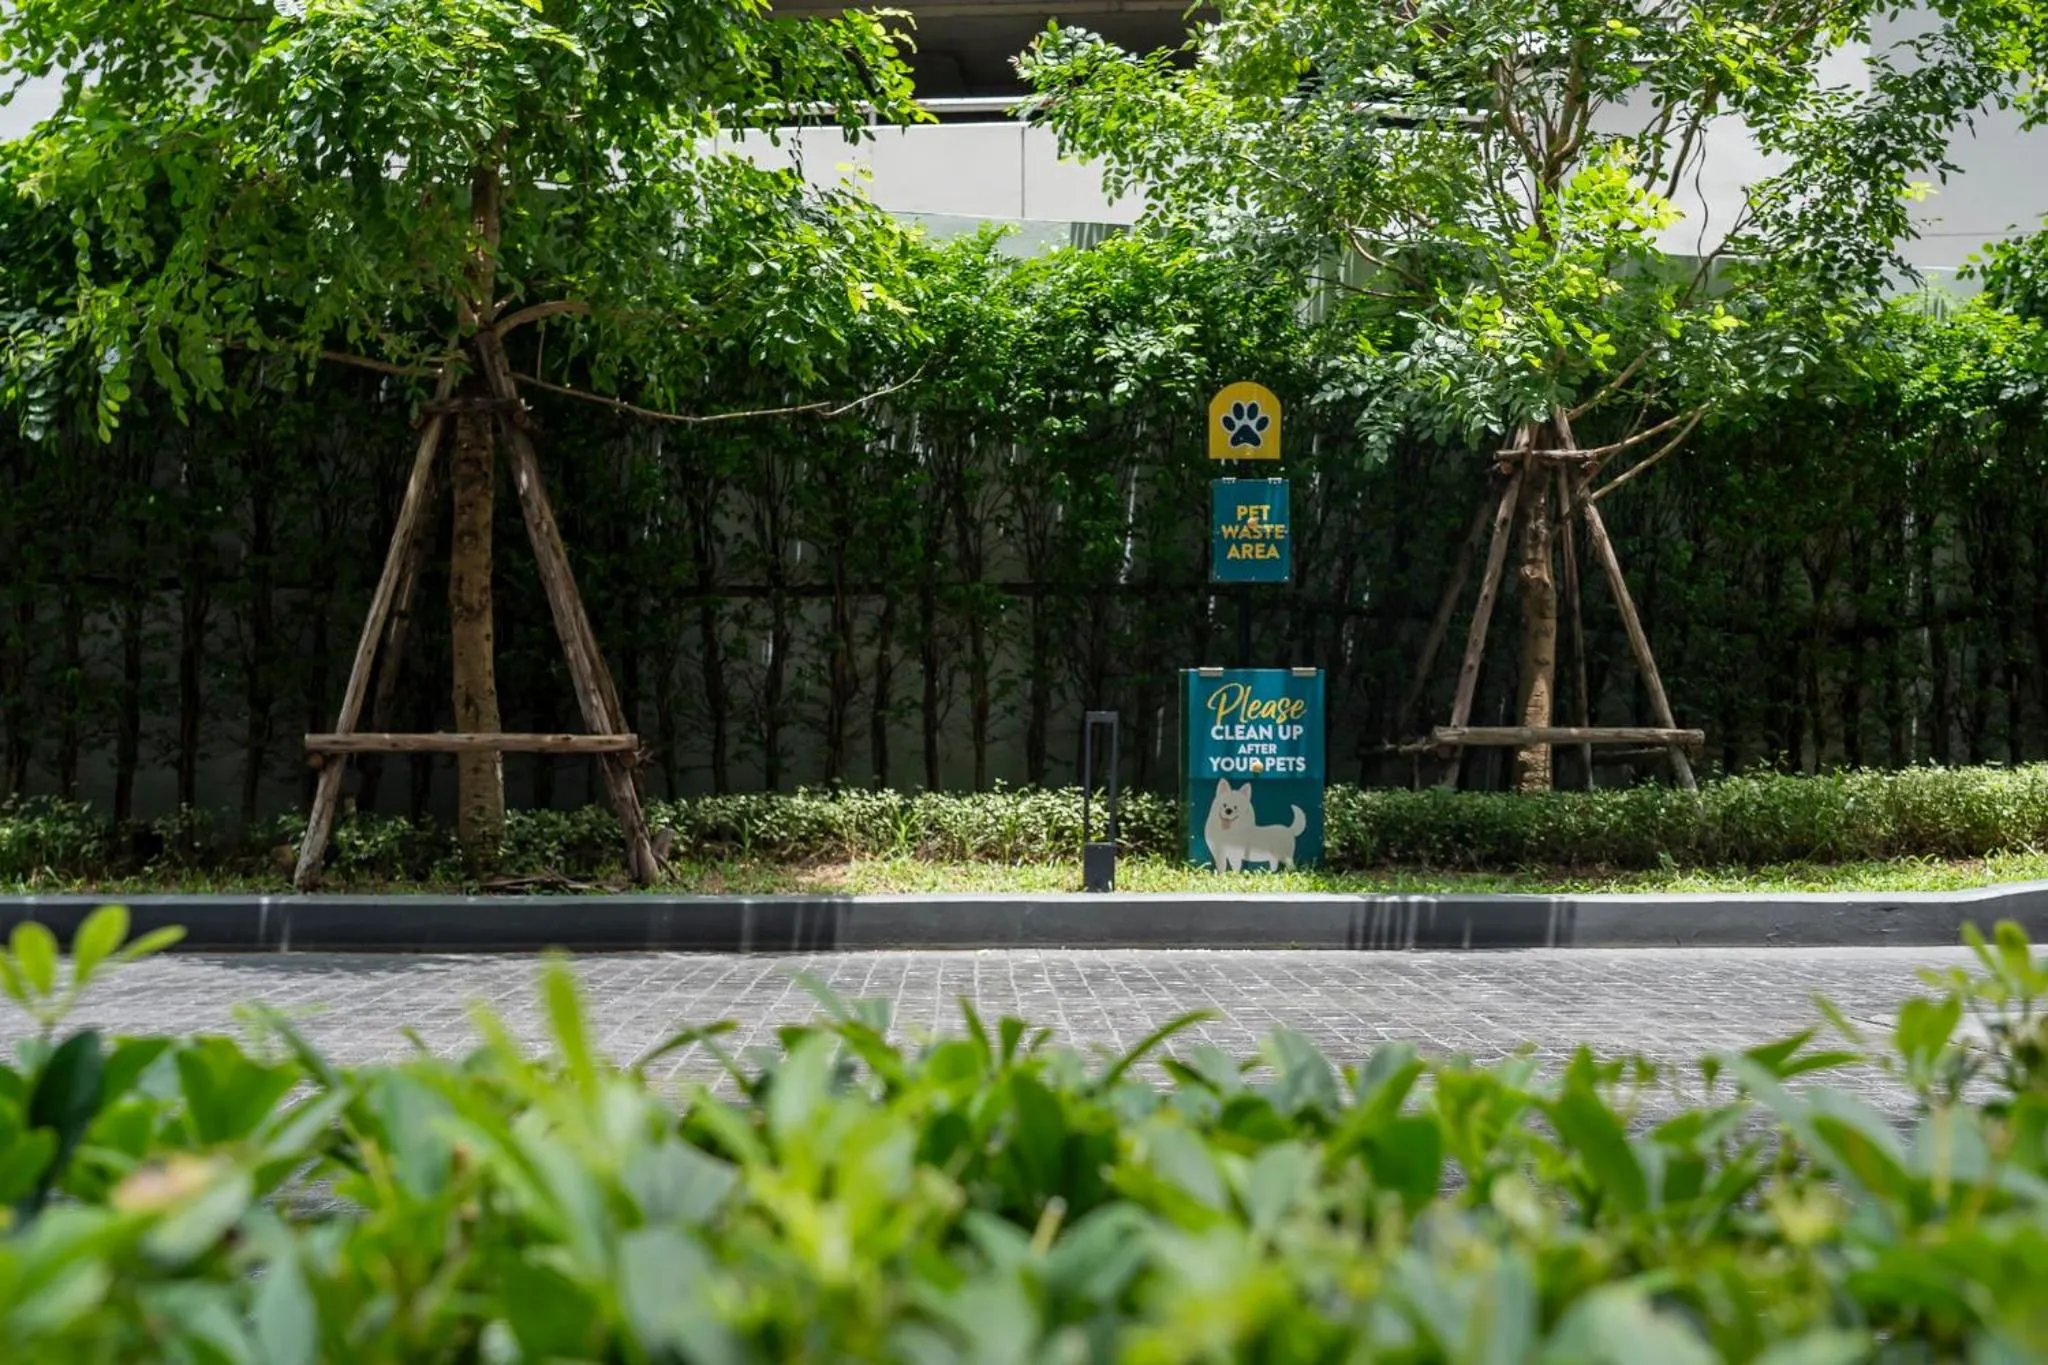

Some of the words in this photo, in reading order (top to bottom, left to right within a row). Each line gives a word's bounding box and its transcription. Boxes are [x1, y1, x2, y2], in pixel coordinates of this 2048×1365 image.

[1236, 505, 1271, 521] PET
[1221, 524, 1286, 540] WASTE
[1226, 543, 1280, 560] AREA
[1207, 682, 1308, 727] Please
[1210, 724, 1274, 741] CLEAN
[1277, 724, 1304, 741] UP
[1238, 743, 1277, 755] AFTER
[1265, 756, 1307, 773] PETS
